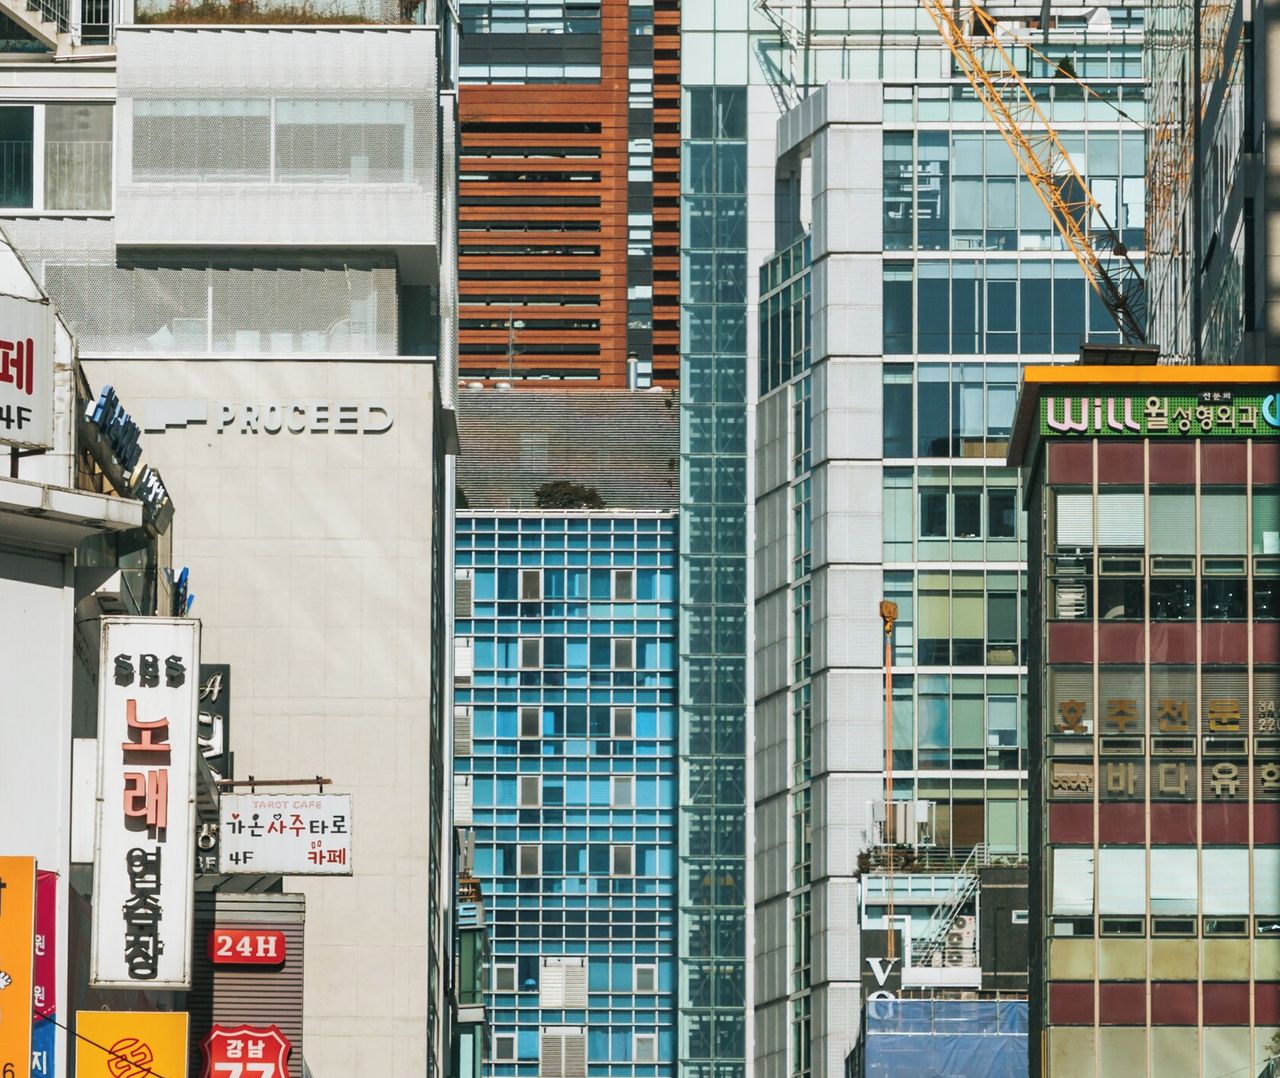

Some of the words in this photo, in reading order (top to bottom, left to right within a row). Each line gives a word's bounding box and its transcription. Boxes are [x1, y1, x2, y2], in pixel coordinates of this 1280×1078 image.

[217, 400, 395, 434] PROCEED
[113, 653, 186, 680] SBS
[252, 801, 288, 809] TAROT
[292, 801, 321, 809] CAFE
[122, 699, 172, 979] 노래연습장
[229, 851, 254, 865] 4F
[307, 840, 346, 865] 카페
[217, 936, 278, 957] 24H
[226, 1040, 264, 1059] 강남
